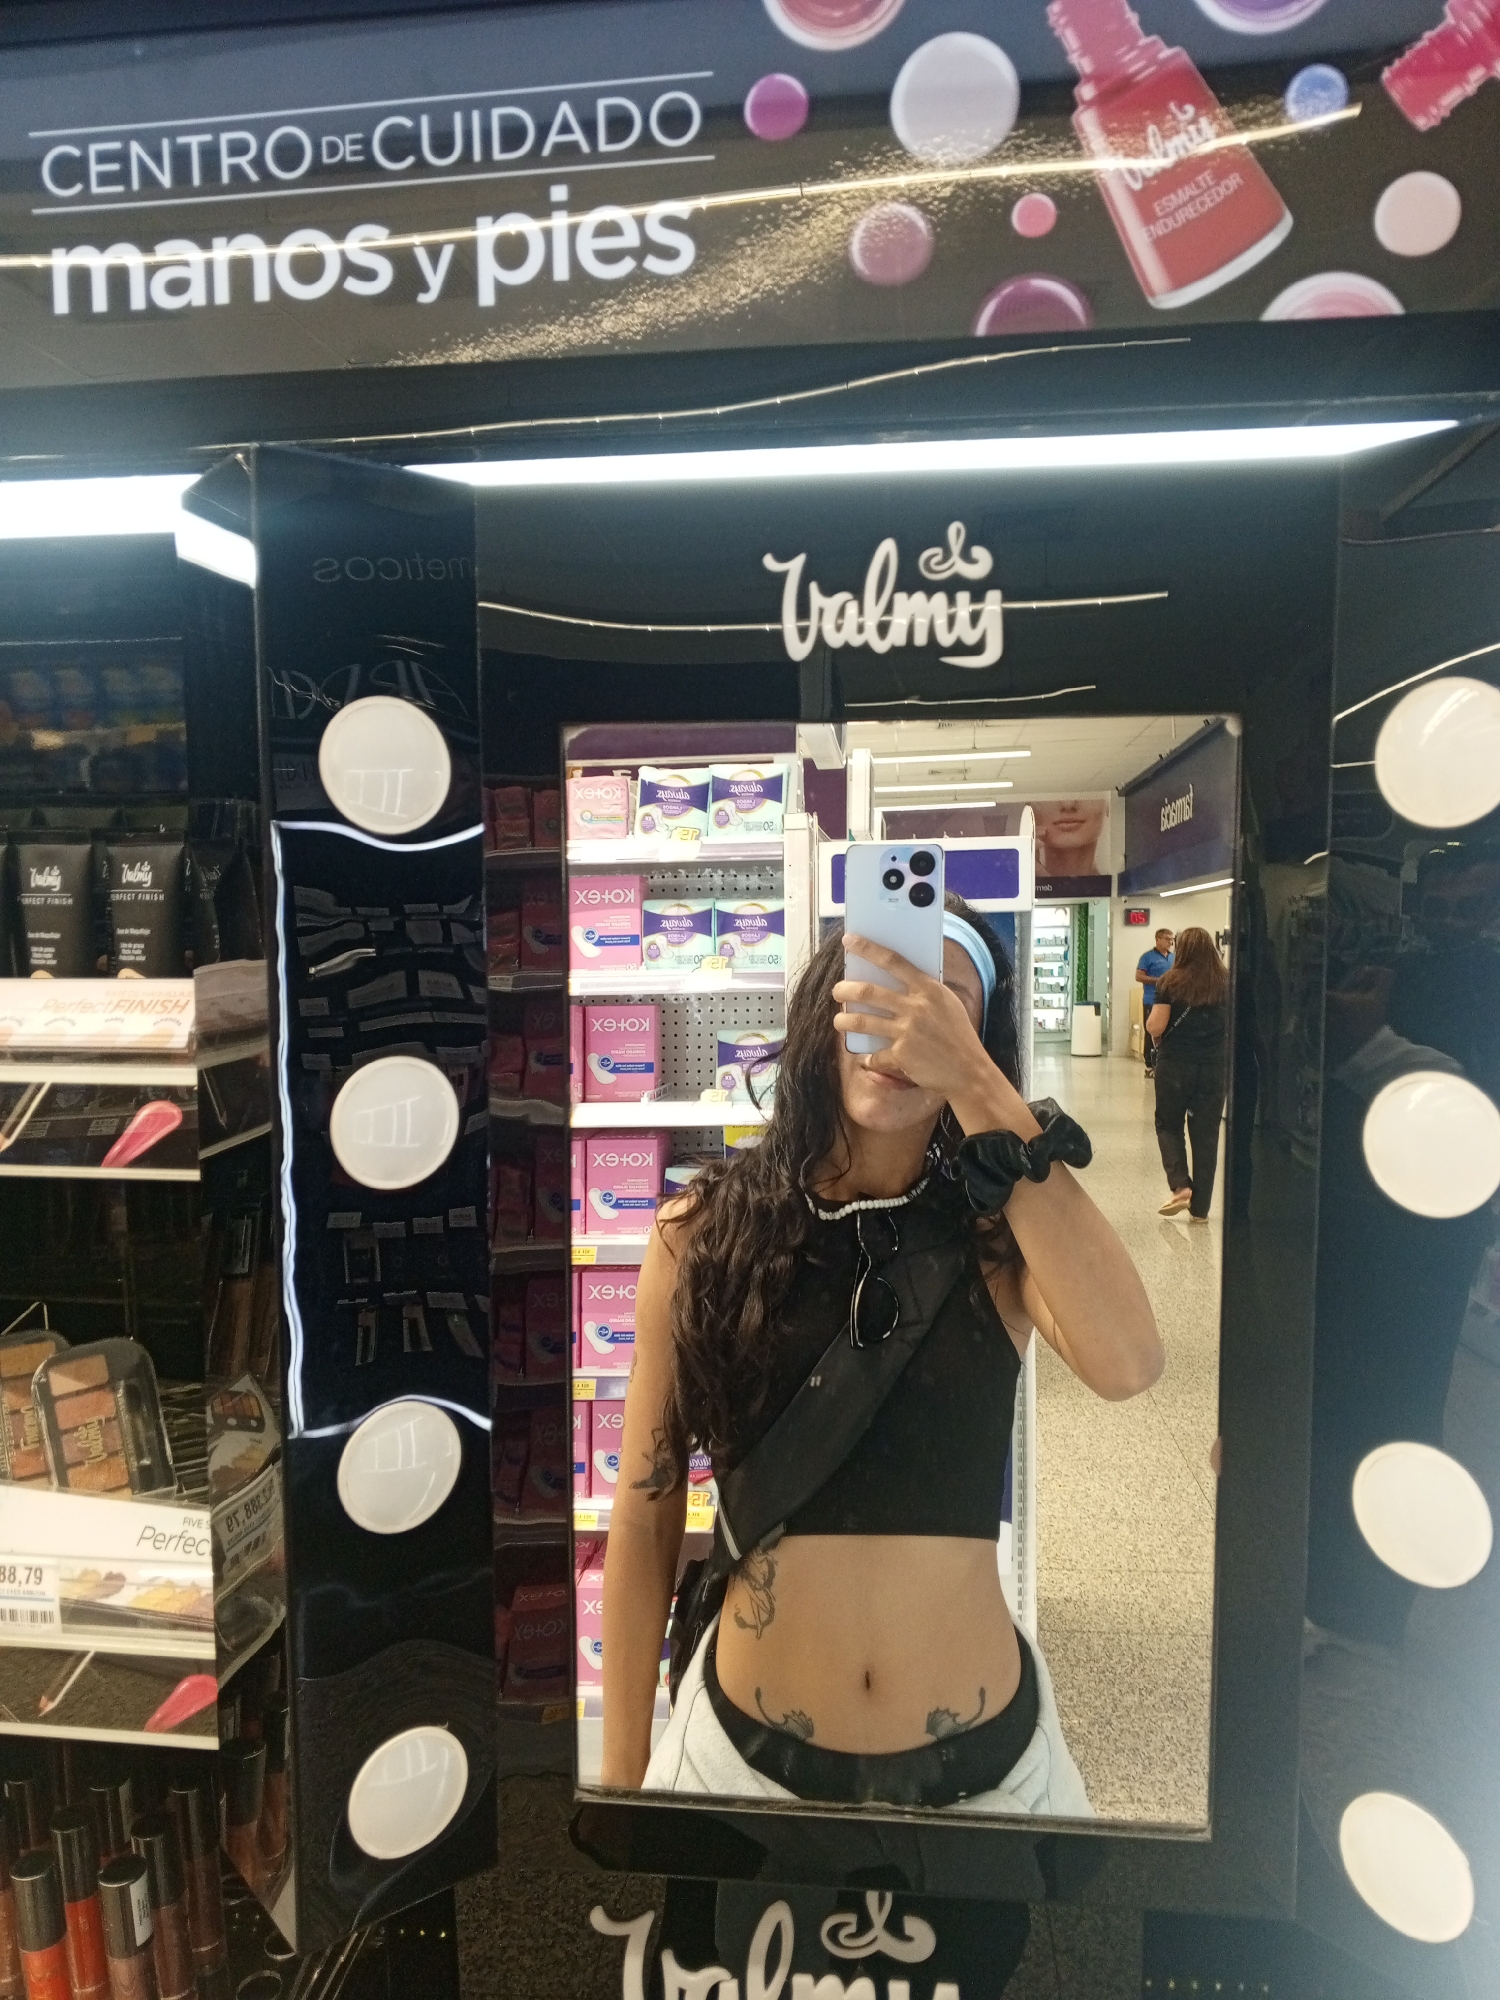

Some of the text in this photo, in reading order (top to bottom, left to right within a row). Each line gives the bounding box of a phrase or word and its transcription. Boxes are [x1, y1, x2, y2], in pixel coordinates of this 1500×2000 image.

[42, 91, 702, 198] CENTRO DE CUIDADO
[1153, 169, 1217, 217] ESMALTE
[52, 184, 697, 315] manos y pies
[762, 535, 1003, 669] Valmy
[122, 861, 152, 887] Valmy
[137, 893, 165, 901] FINISH
[136, 1525, 212, 1557] Perfec
[183, 1516, 203, 1529] FIVE
